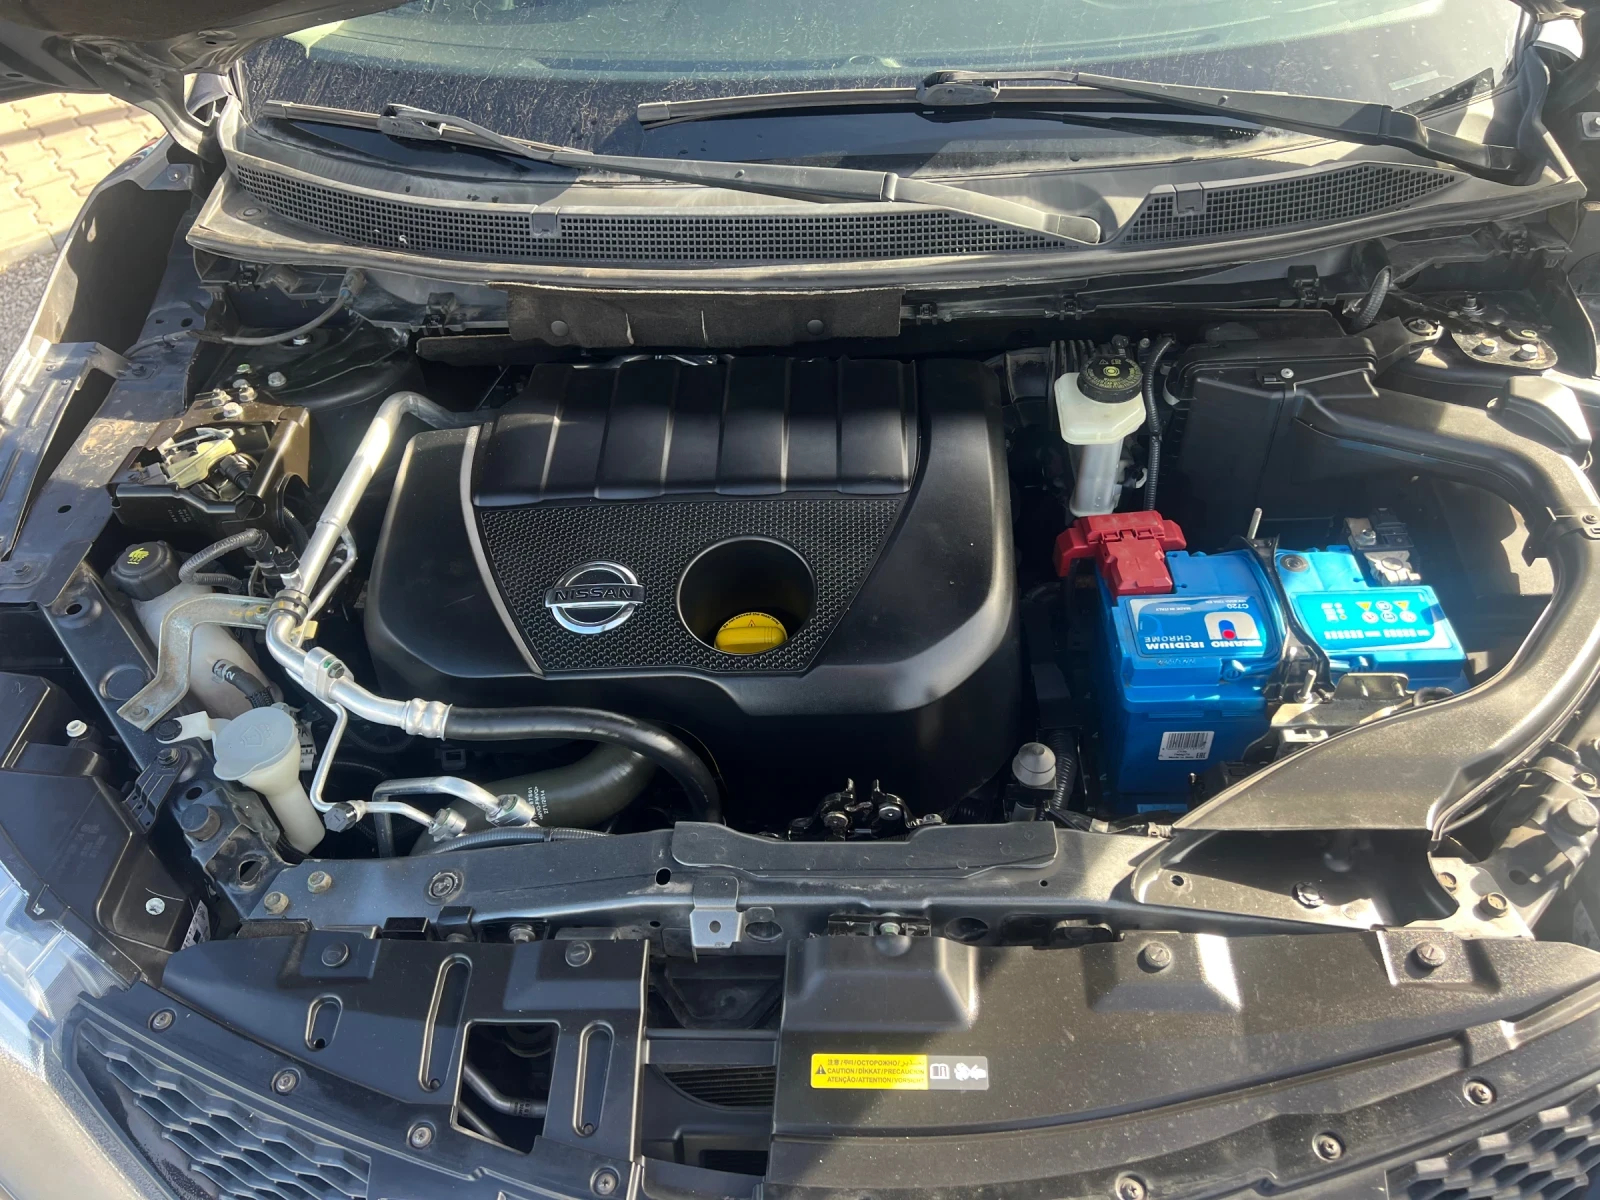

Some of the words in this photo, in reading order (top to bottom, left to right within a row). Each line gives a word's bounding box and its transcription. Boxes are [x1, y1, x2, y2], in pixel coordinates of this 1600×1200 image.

[554, 587, 634, 601] NISSAN
[1144, 635, 1192, 643] CHROME
[1145, 641, 1205, 650] IRIDIUM
[827, 1067, 855, 1075] CAUTION
[827, 1075, 856, 1084] ATENÇÃO
